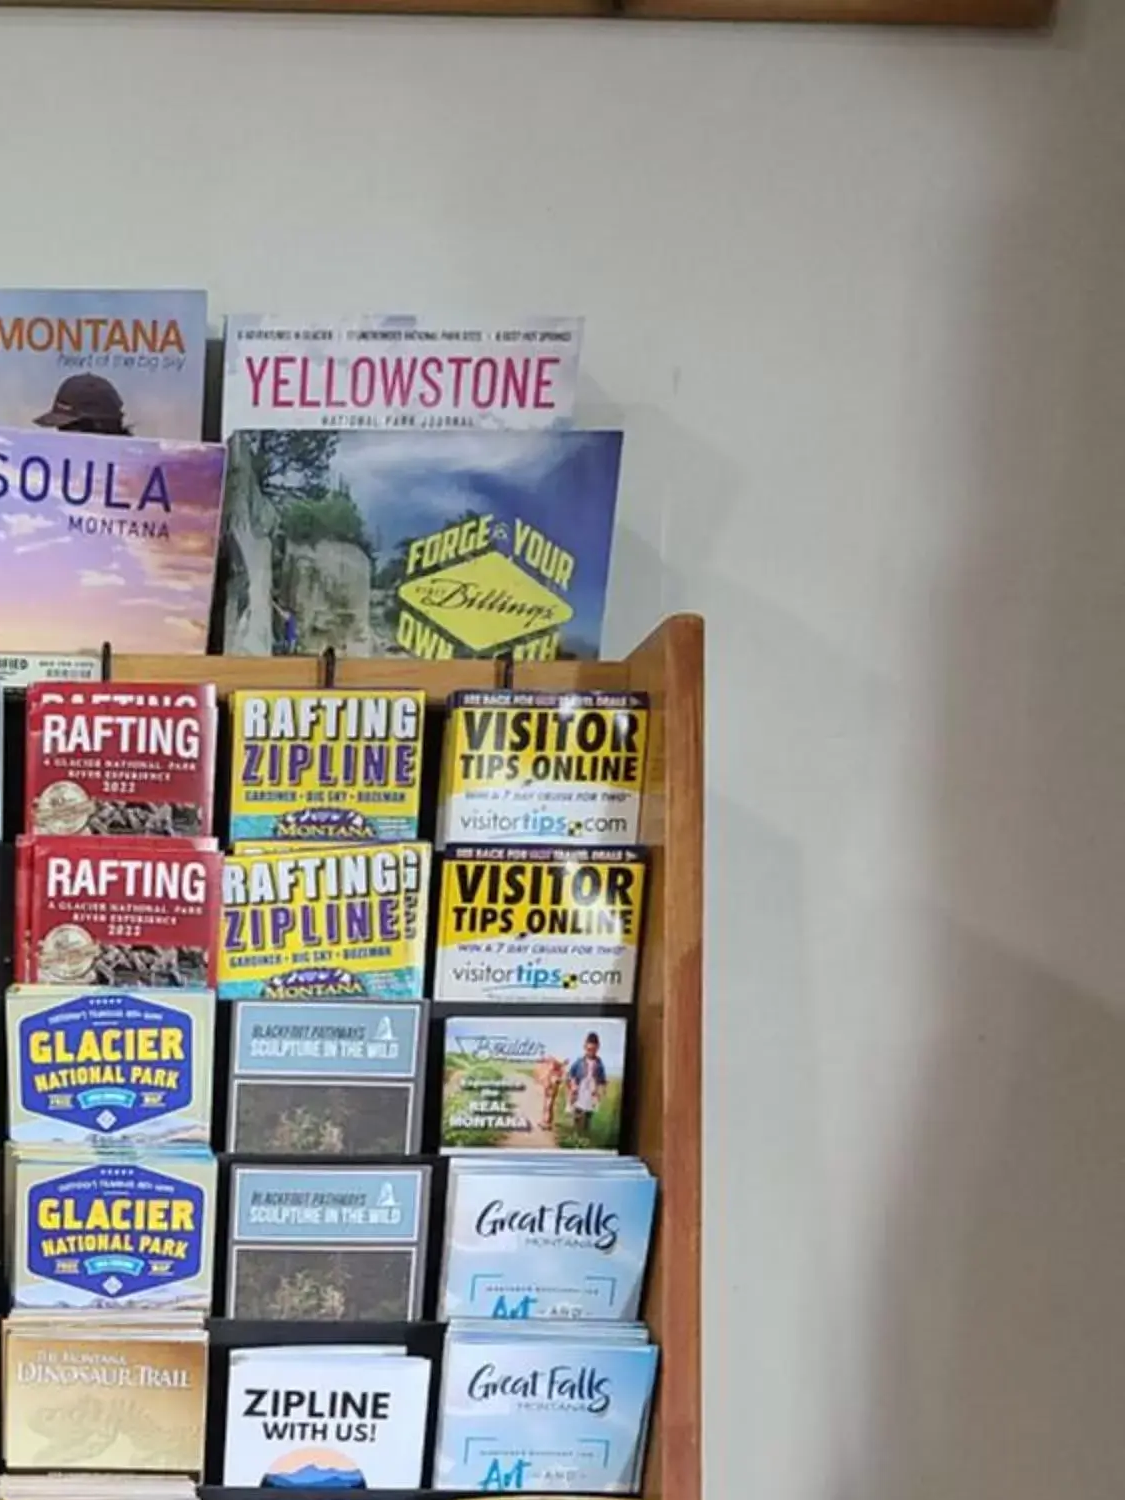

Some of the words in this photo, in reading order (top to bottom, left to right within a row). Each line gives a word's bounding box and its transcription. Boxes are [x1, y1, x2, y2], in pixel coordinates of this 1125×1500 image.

[245, 356, 561, 409] YELLOWSTONE
[321, 416, 377, 427] NATIONAL
[386, 416, 415, 427] PARK
[422, 416, 474, 428] JOURNAL
[68, 515, 170, 540] MONTANA
[407, 514, 494, 575] FORGE
[513, 518, 575, 591] YOUR
[421, 578, 555, 629] Billings
[243, 697, 420, 741] RAFTING
[463, 711, 639, 752] VISITOR
[42, 715, 200, 759] RAFTING
[241, 743, 417, 787] ZIPLINE
[460, 754, 519, 780] TIPS
[533, 754, 638, 781] ONLINE
[102, 781, 137, 793] 2022
[47, 858, 207, 902] RAFTING
[222, 851, 401, 906] RAFTING
[455, 864, 634, 906] VISITOR
[224, 898, 401, 952] ZIPLINE
[452, 907, 514, 933] TIPS
[527, 908, 632, 935] ONLINE
[29, 1027, 185, 1064] GLACIER
[250, 1040, 322, 1058] SCULPTURE
[324, 1042, 336, 1058] IN
[338, 1042, 364, 1058] THE
[366, 1042, 399, 1059] WILD
[34, 1065, 125, 1093] NATIONAL
[131, 1066, 179, 1089] PARK
[38, 1198, 195, 1231] GLACIER
[250, 1207, 322, 1223] SCULPTURE
[324, 1208, 337, 1223] IN
[339, 1208, 364, 1223] THE
[365, 1208, 401, 1224] WILD
[476, 1200, 554, 1238] Great
[555, 1201, 620, 1250] Falls
[41, 1234, 134, 1258] NATIONAL
[139, 1235, 189, 1259] PARK
[492, 1295, 539, 1319] Art
[17, 1363, 130, 1387] DINOSAUR
[138, 1366, 193, 1388] TRAIL
[468, 1363, 546, 1401] Great
[547, 1365, 611, 1413] Falls
[243, 1388, 392, 1419] ZIPLINE
[262, 1421, 328, 1441] WITH
[334, 1422, 377, 1442] US!
[478, 1458, 532, 1490] Art
